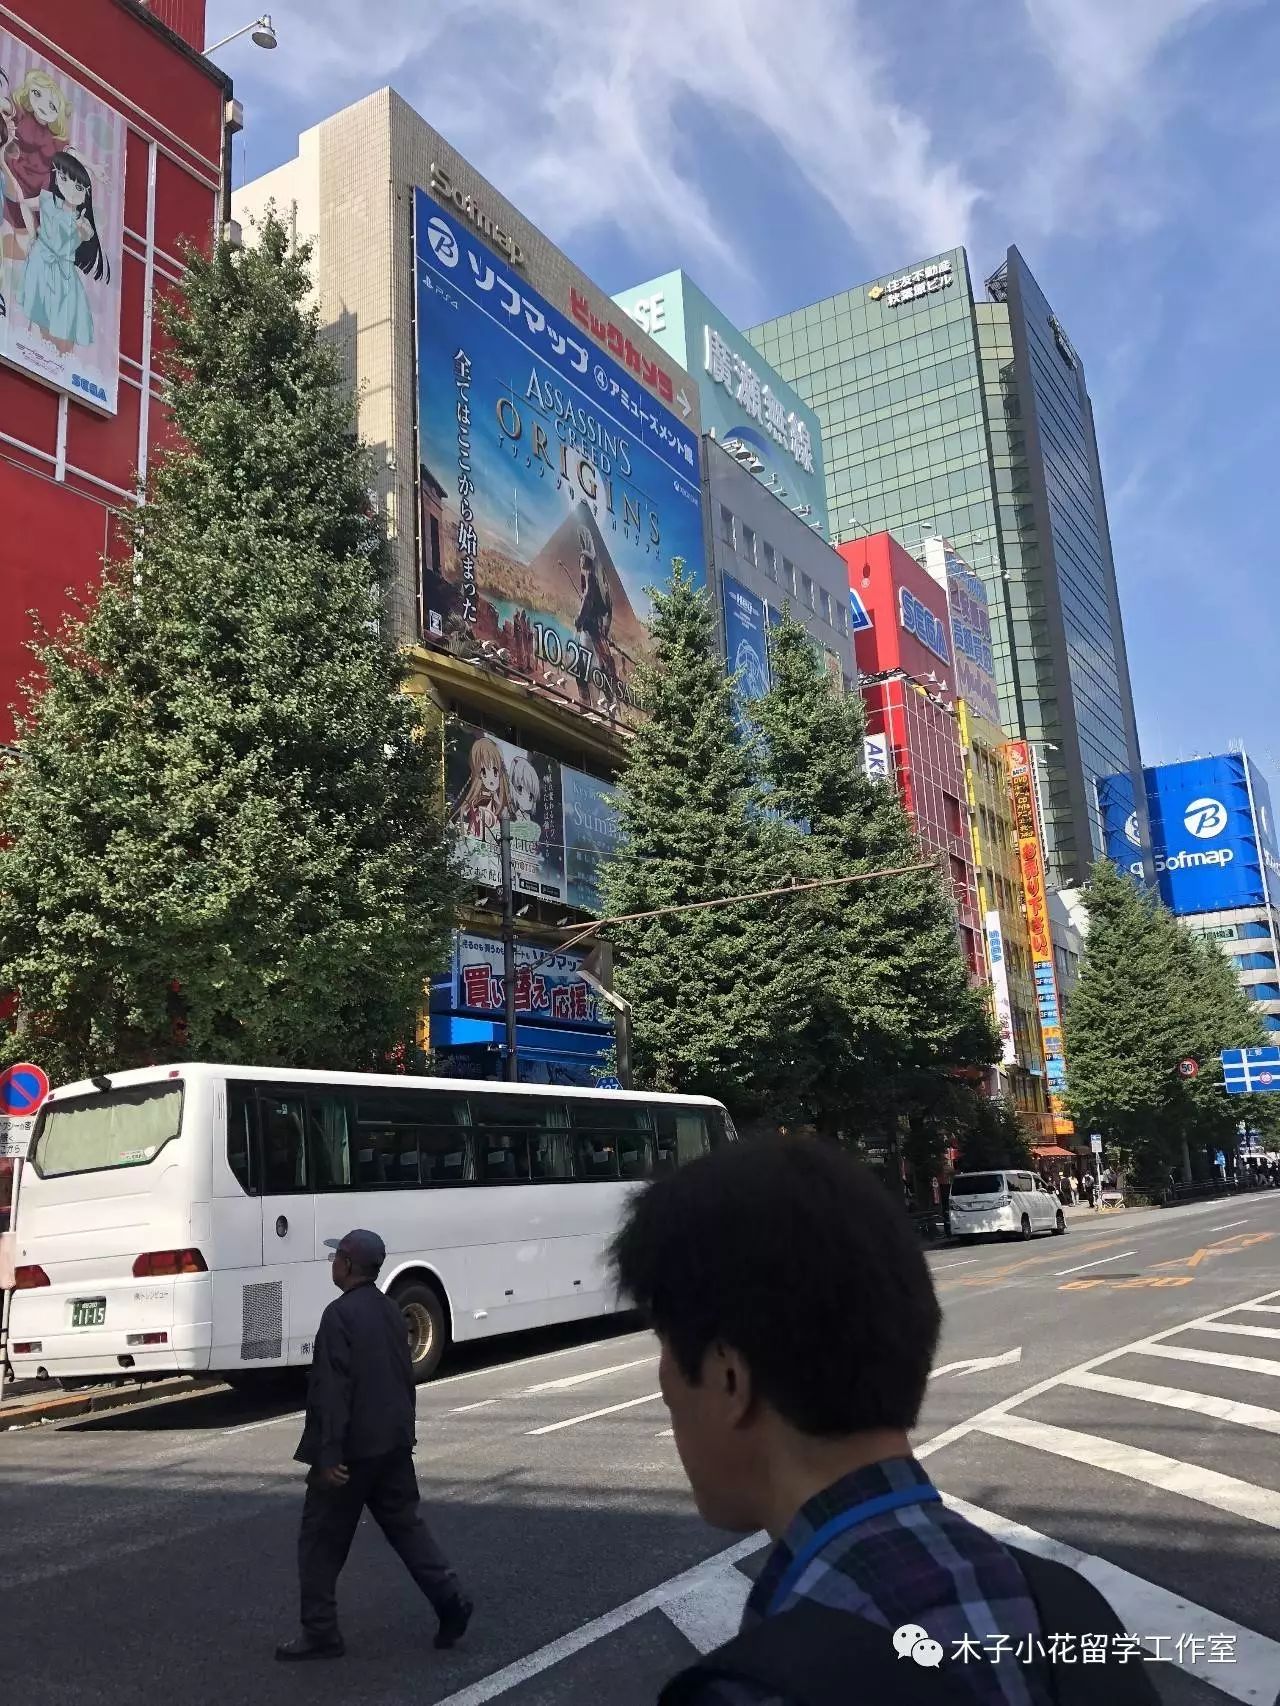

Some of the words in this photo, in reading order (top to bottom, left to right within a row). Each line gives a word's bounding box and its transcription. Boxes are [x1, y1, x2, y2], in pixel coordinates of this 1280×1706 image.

[430, 162, 524, 266] Sofmap
[467, 250, 588, 374] ソフマップ
[886, 260, 951, 292] 住友不動産
[71, 373, 108, 402] SEGA
[454, 348, 477, 622] 全てはここから始まった
[496, 397, 660, 546] ORIGINS
[554, 418, 611, 476] CREED
[534, 623, 594, 683] 10.27
[592, 668, 614, 699] ON
[898, 584, 950, 668] SEGA
[1153, 848, 1234, 873] Sofmap
